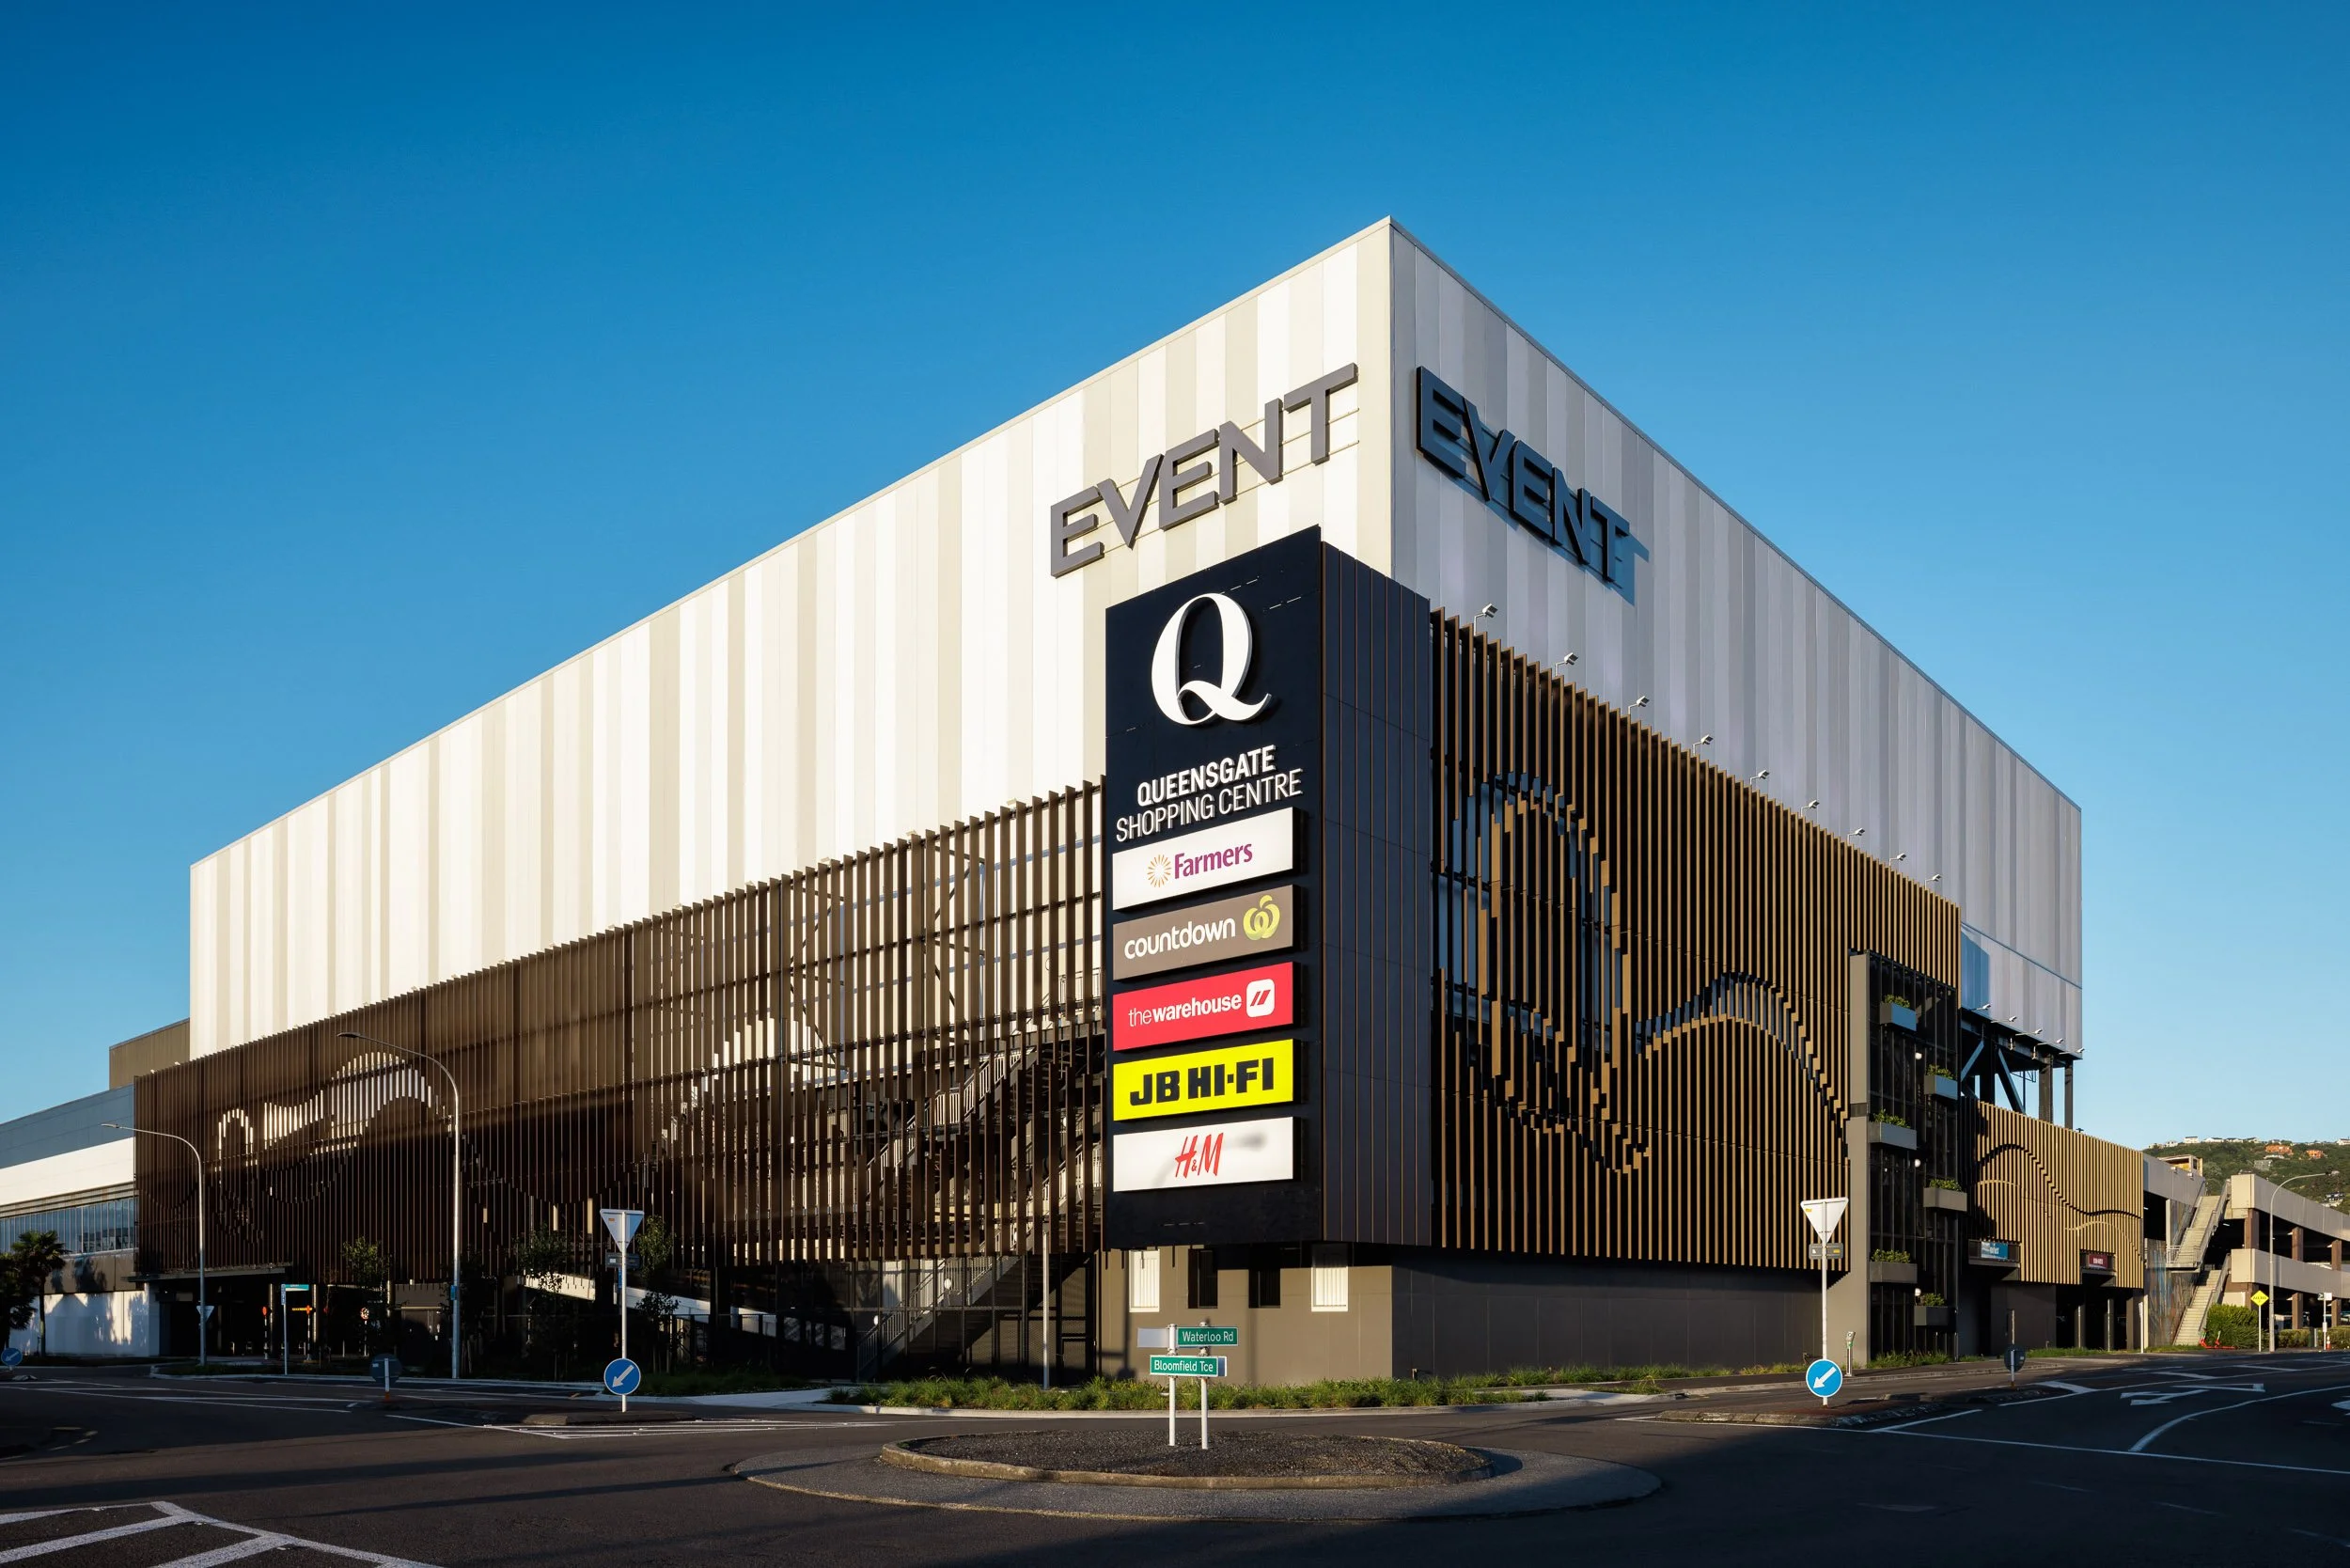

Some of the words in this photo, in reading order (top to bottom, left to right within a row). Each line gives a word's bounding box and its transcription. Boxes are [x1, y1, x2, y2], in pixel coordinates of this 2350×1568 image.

[1050, 362, 1358, 578] EVENT
[1417, 366, 1630, 583] EVENT
[1151, 592, 1272, 726] Q
[1137, 744, 1276, 808] QUEENSGATE
[1116, 793, 1214, 842] SHOPPING
[1218, 767, 1303, 815] CENTRE
[1174, 842, 1253, 880] Farmers
[1123, 917, 1236, 960] countdown
[1129, 1070, 1181, 1106] JB
[1174, 1132, 1224, 1179] H&M
[1182, 1330, 1222, 1342] Waterloo
[1223, 1331, 1234, 1342] Rd
[1153, 1359, 1198, 1372] Bloomfield
[1199, 1360, 1214, 1372] Tce
